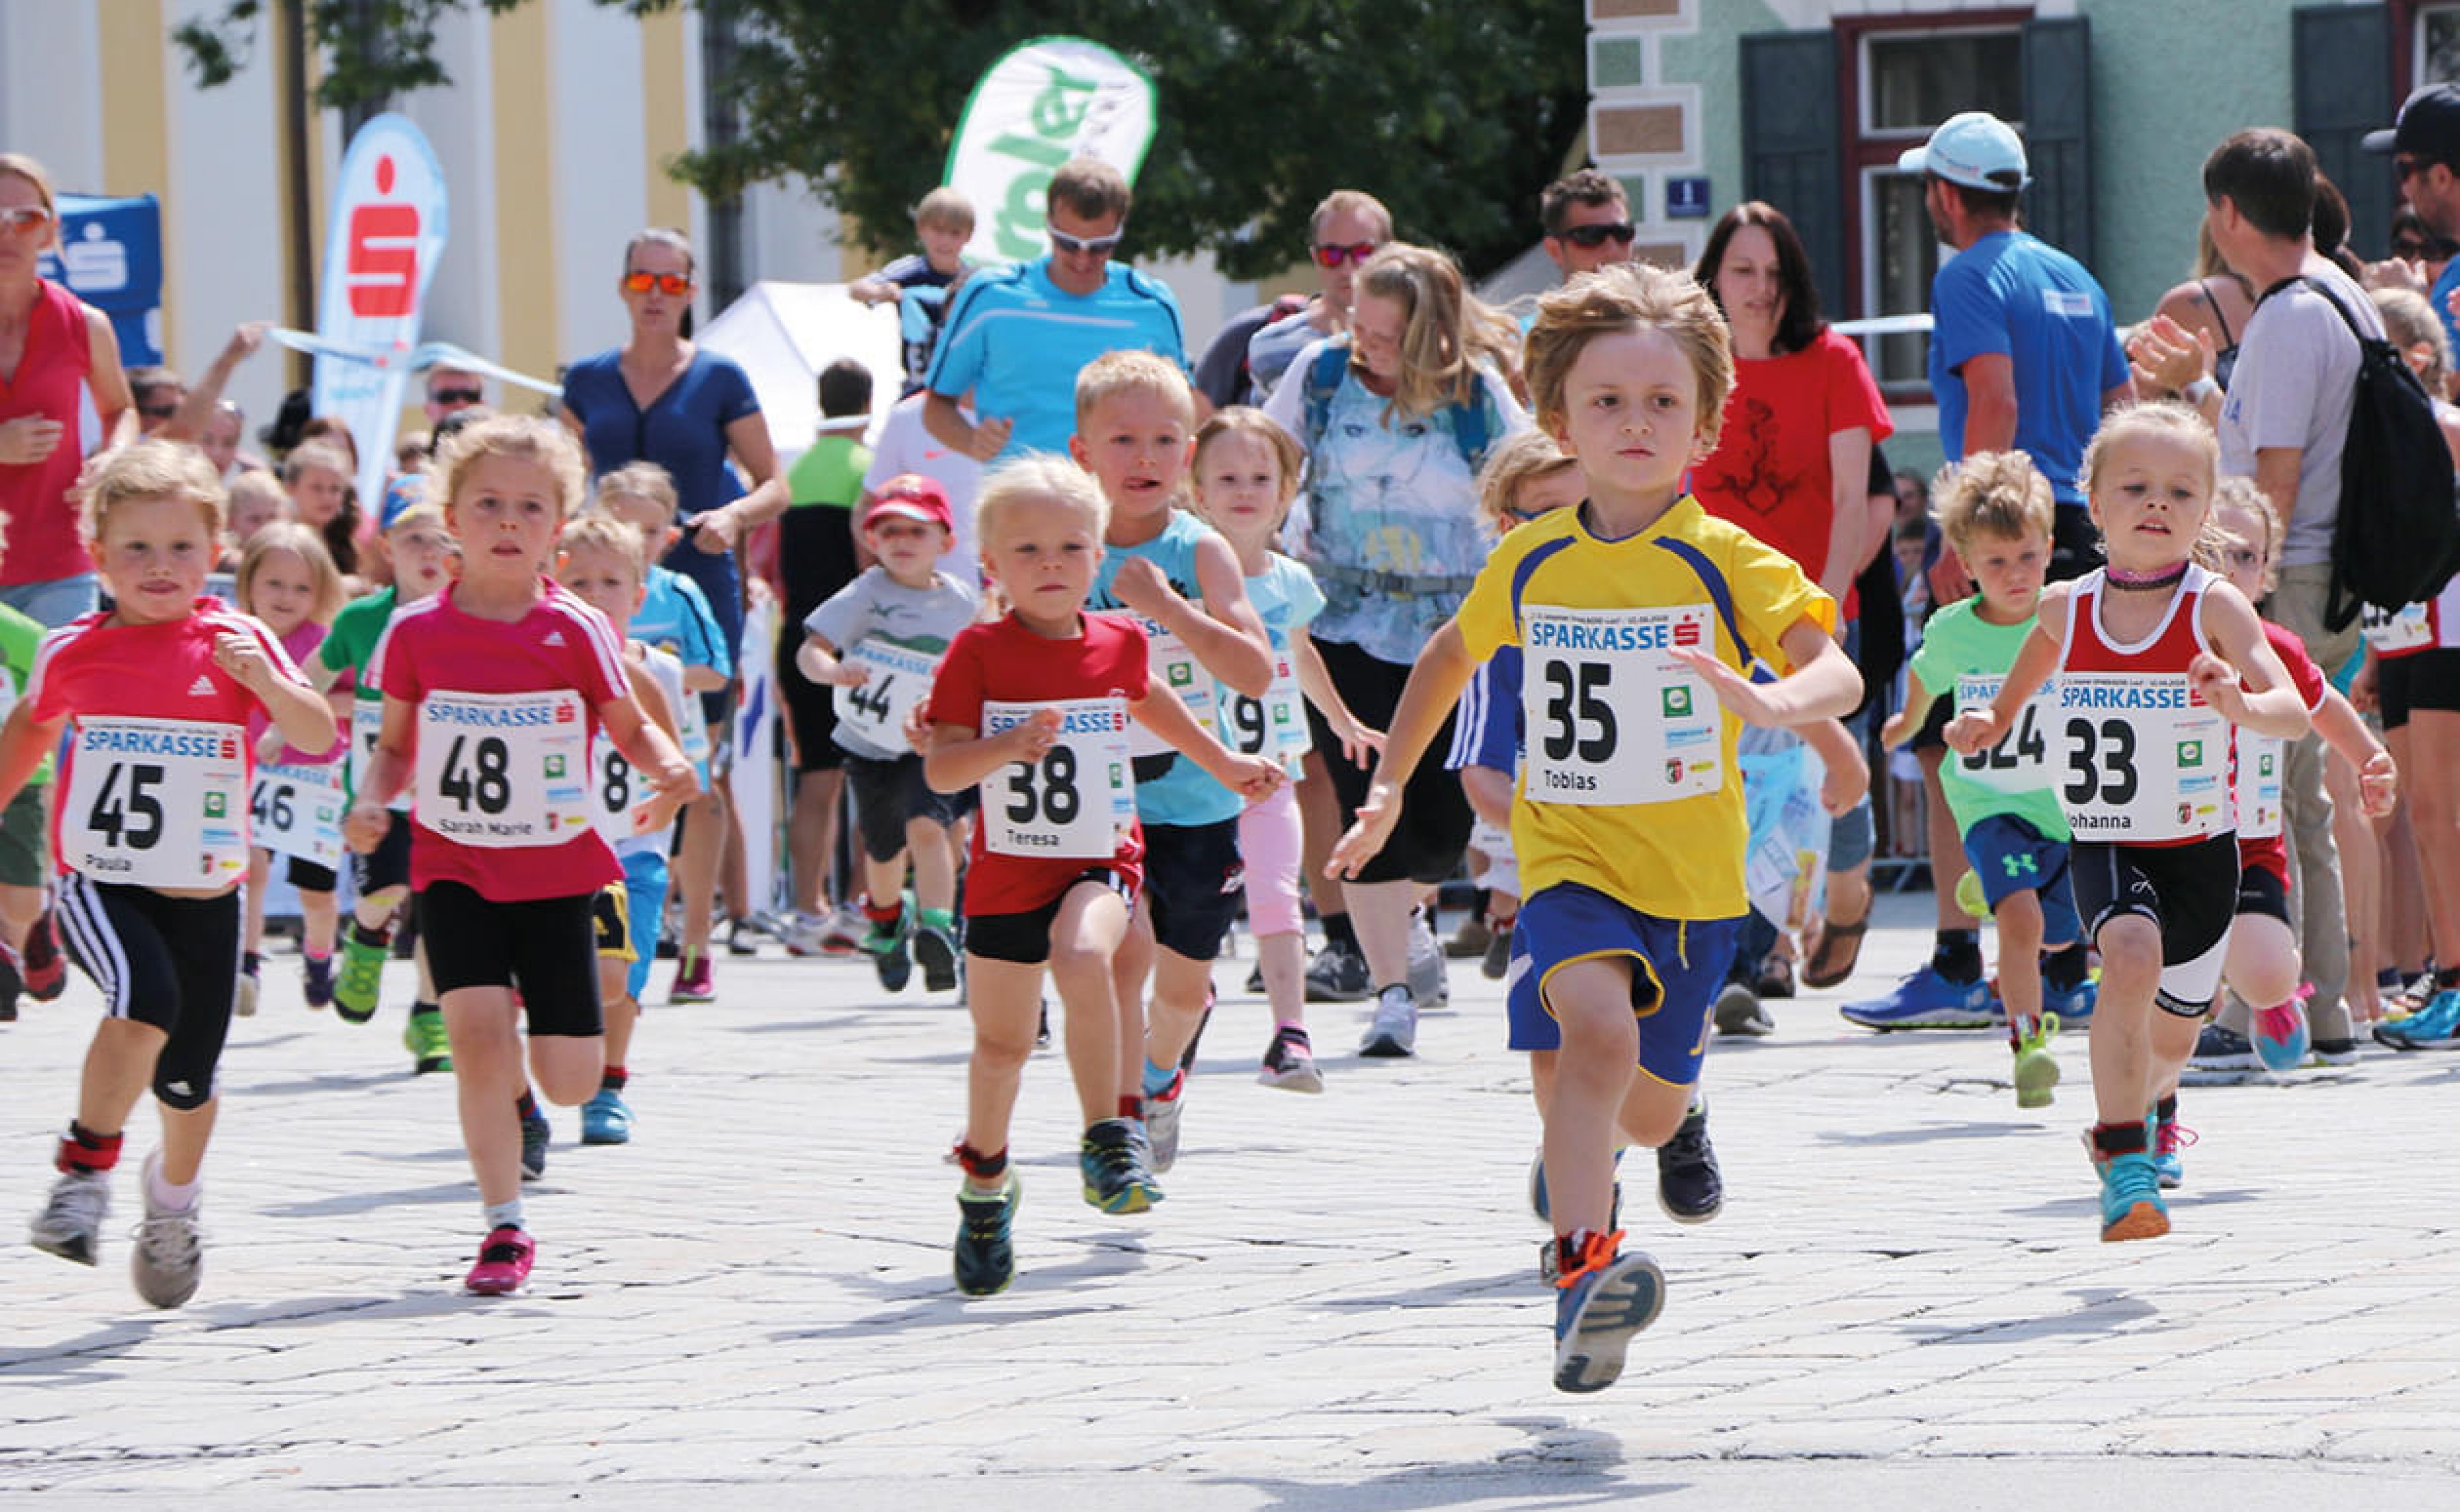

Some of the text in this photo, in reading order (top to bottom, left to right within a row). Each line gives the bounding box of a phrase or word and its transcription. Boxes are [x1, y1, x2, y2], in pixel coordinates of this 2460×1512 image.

[1532, 622, 1668, 650] SPARKASSE
[1544, 660, 1617, 763] 35
[2061, 687, 2185, 709] SPARKASSE
[428, 703, 551, 726] SPARKASSE
[84, 731, 218, 758] SPARKASSE
[2065, 717, 2139, 804] 33
[440, 735, 511, 814] 48
[1006, 745, 1079, 824] 38
[1544, 769, 1598, 791] Tobias
[88, 762, 165, 850] 45
[250, 779, 295, 832] 46
[2065, 812, 2132, 830] ohanna
[1005, 828, 1060, 847] Teresa
[85, 854, 132, 872] Paula
